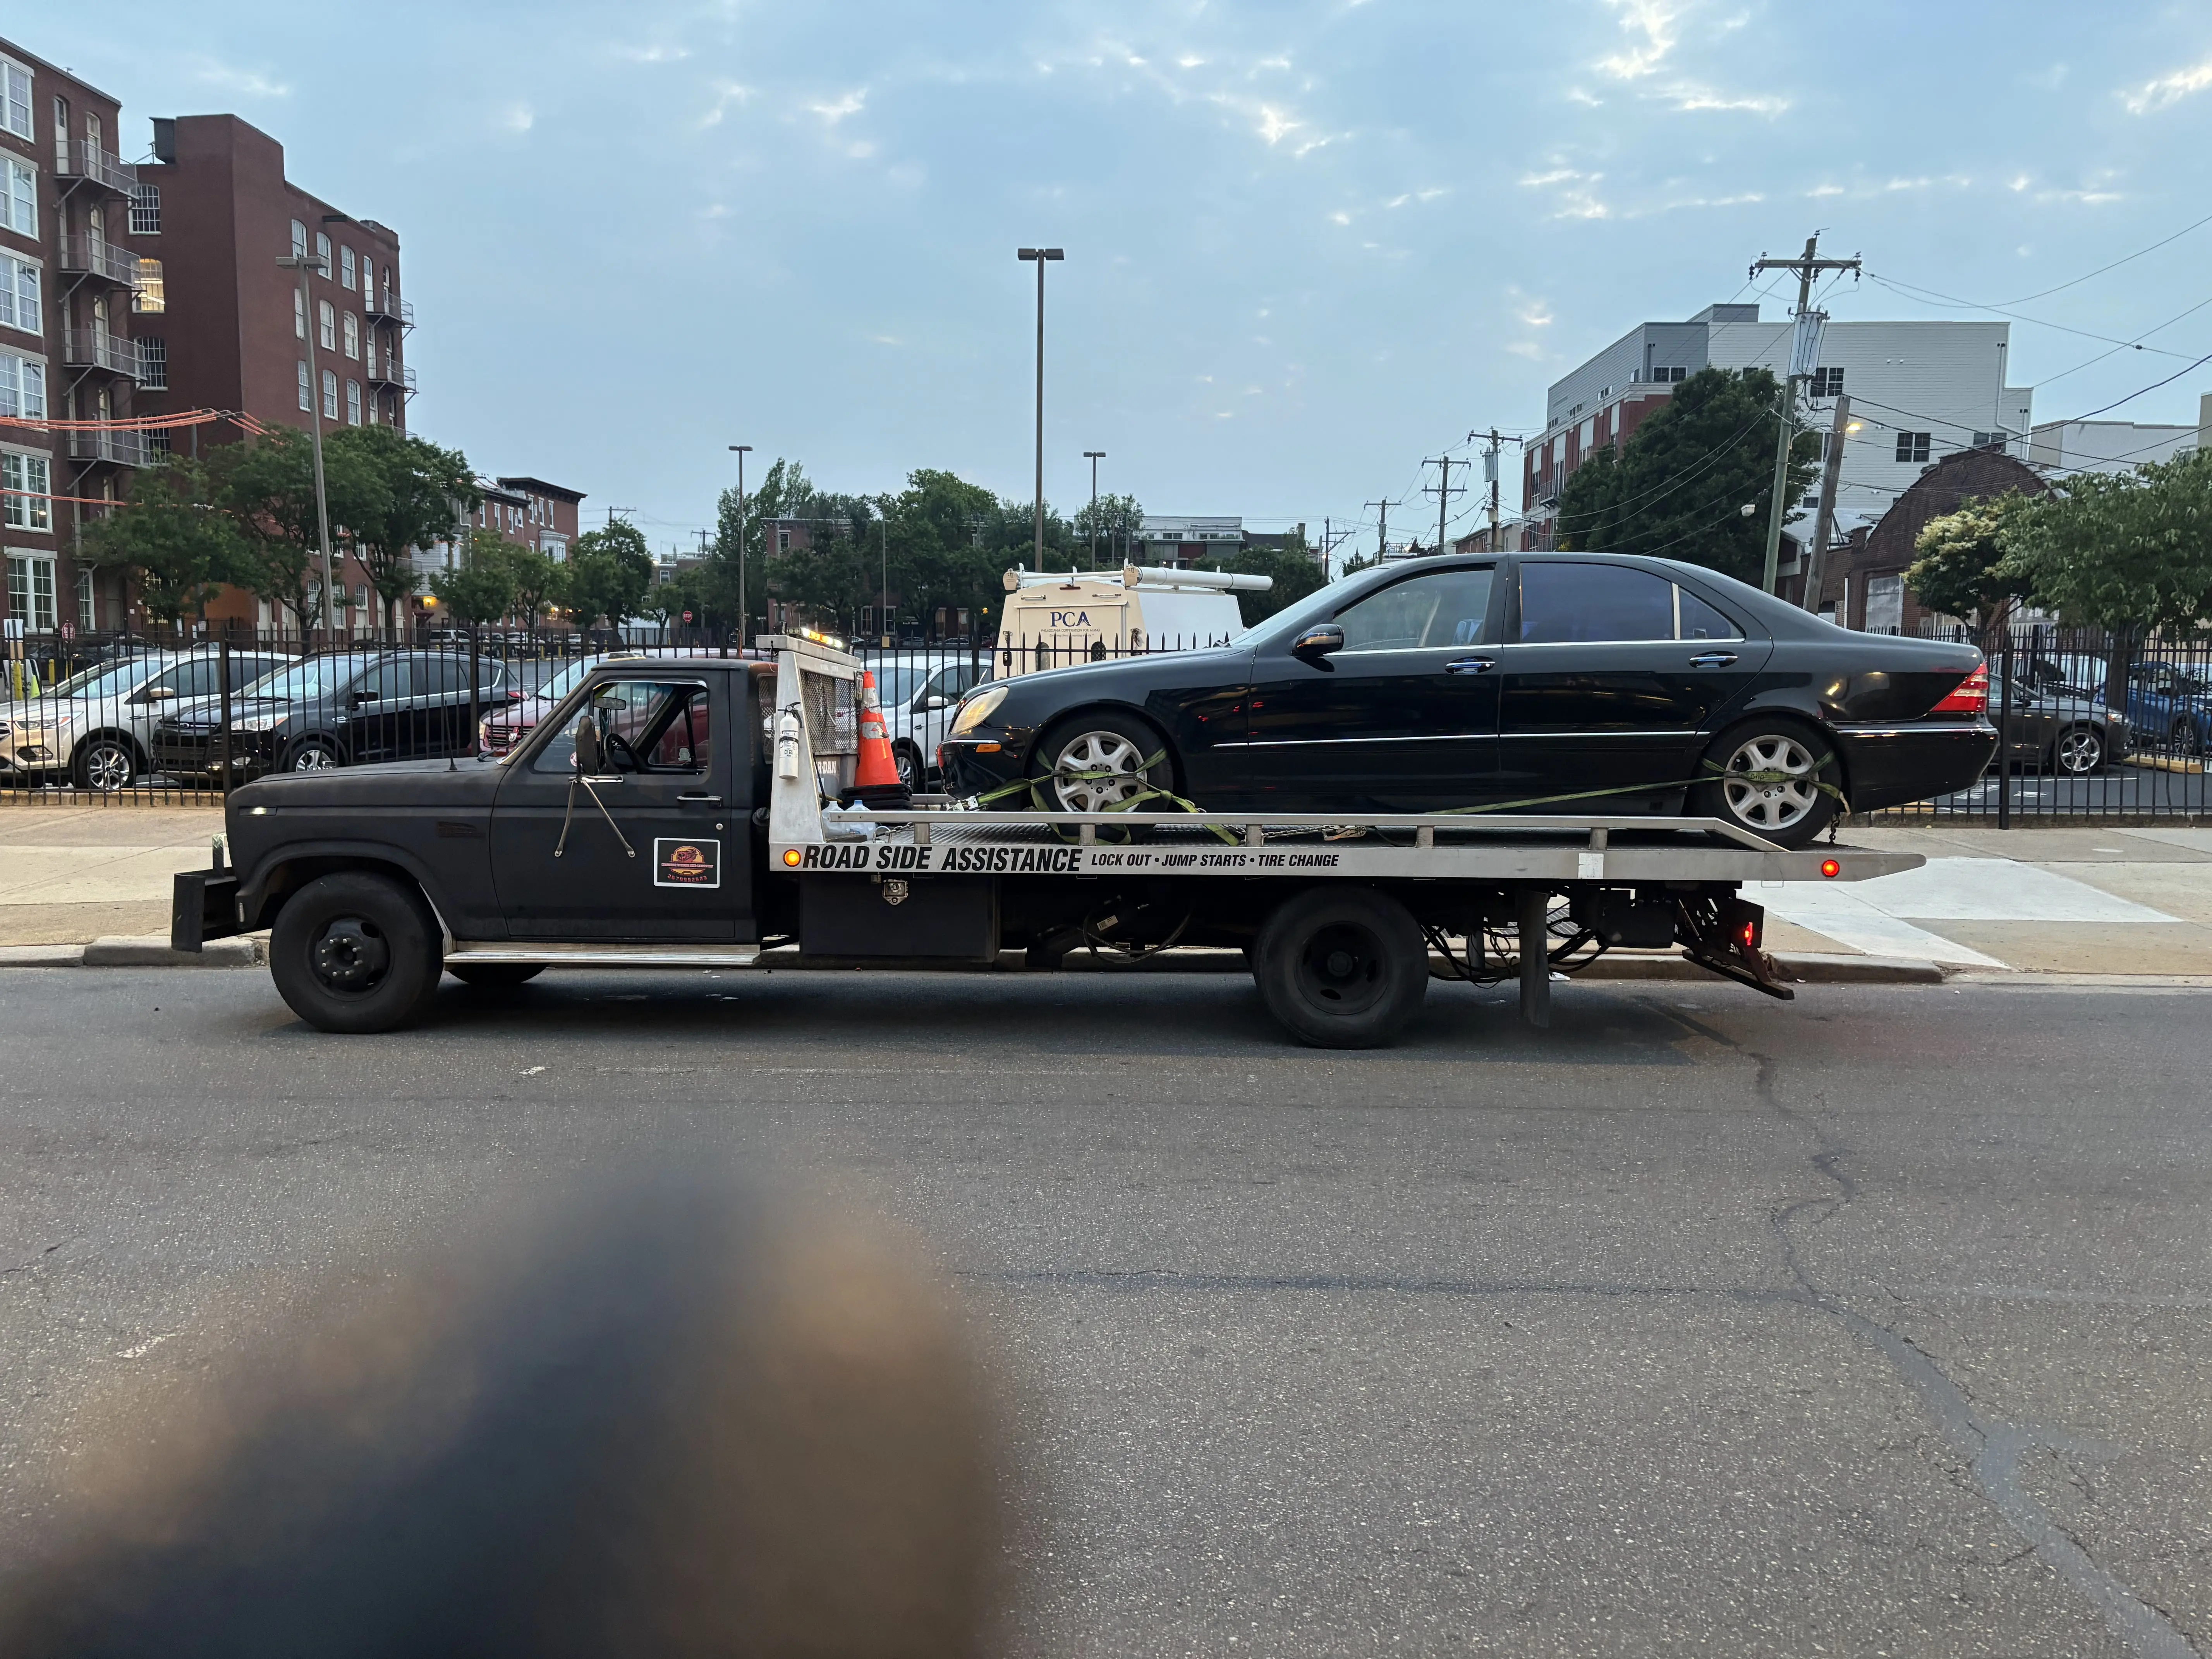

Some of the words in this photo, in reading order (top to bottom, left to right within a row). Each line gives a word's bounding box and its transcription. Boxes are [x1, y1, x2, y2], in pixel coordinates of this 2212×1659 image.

[1050, 611, 1091, 627] PCA
[803, 845, 870, 869] ROAD
[876, 846, 932, 869] SIDE
[941, 847, 1083, 872] ASSISTANCE
[1091, 854, 1124, 866] LOCK
[1127, 854, 1152, 866] OUT
[1161, 854, 1197, 866] JUMP
[1200, 854, 1247, 867] STARTS
[1258, 855, 1286, 866] TIRE
[1289, 855, 1340, 867] CHANGE
